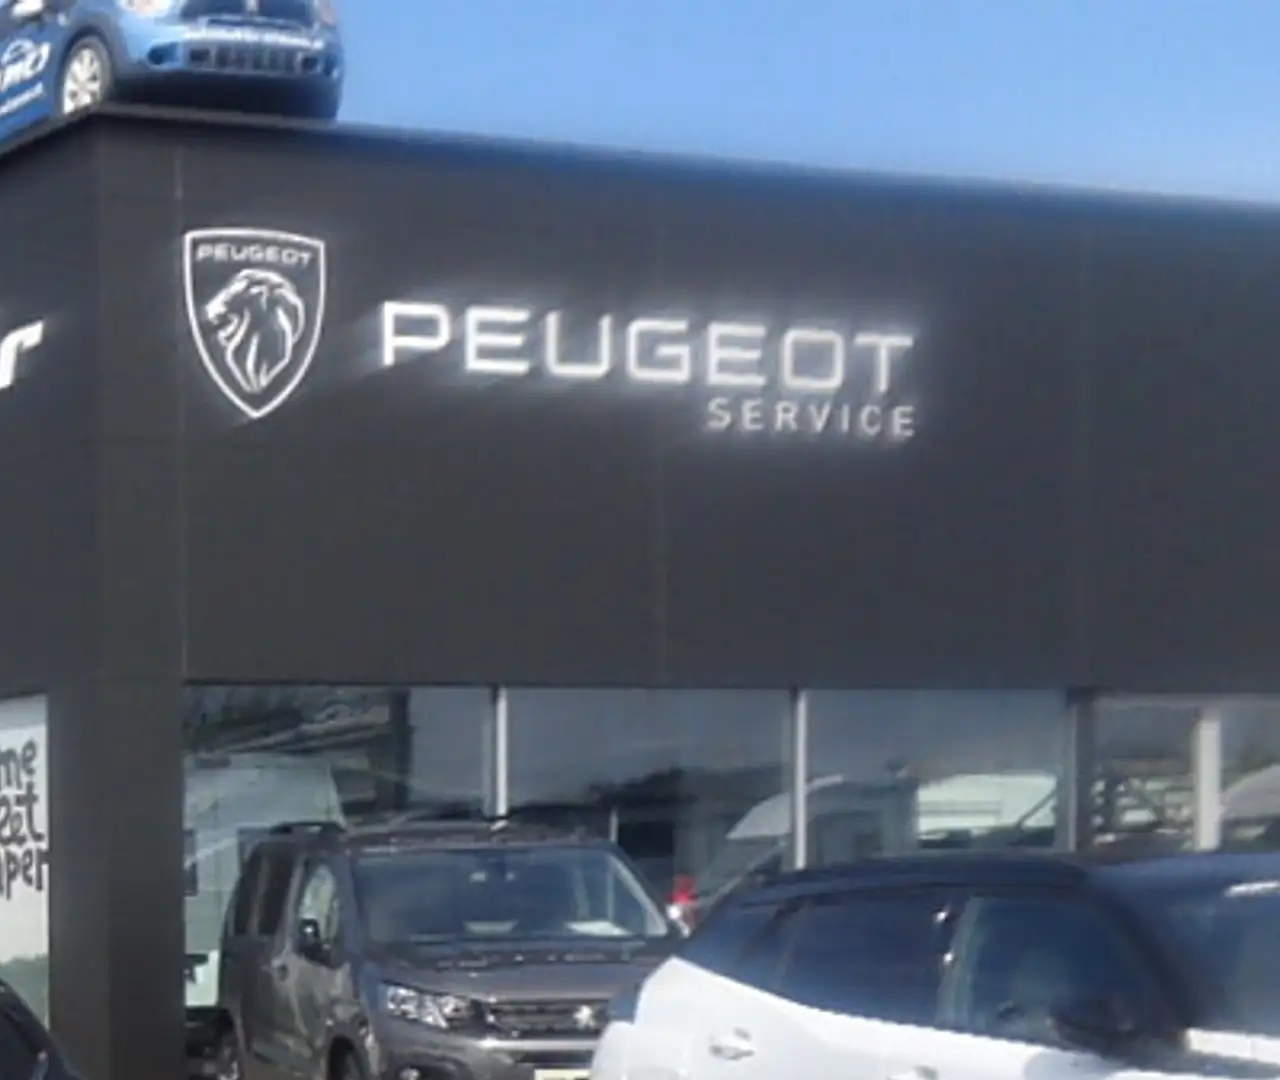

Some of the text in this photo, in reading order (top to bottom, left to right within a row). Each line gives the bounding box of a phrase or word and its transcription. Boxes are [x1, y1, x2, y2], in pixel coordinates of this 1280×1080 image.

[195, 243, 315, 267] PEUGEOT
[381, 301, 915, 394] PEUGEOT
[707, 397, 917, 438] SERVICE
